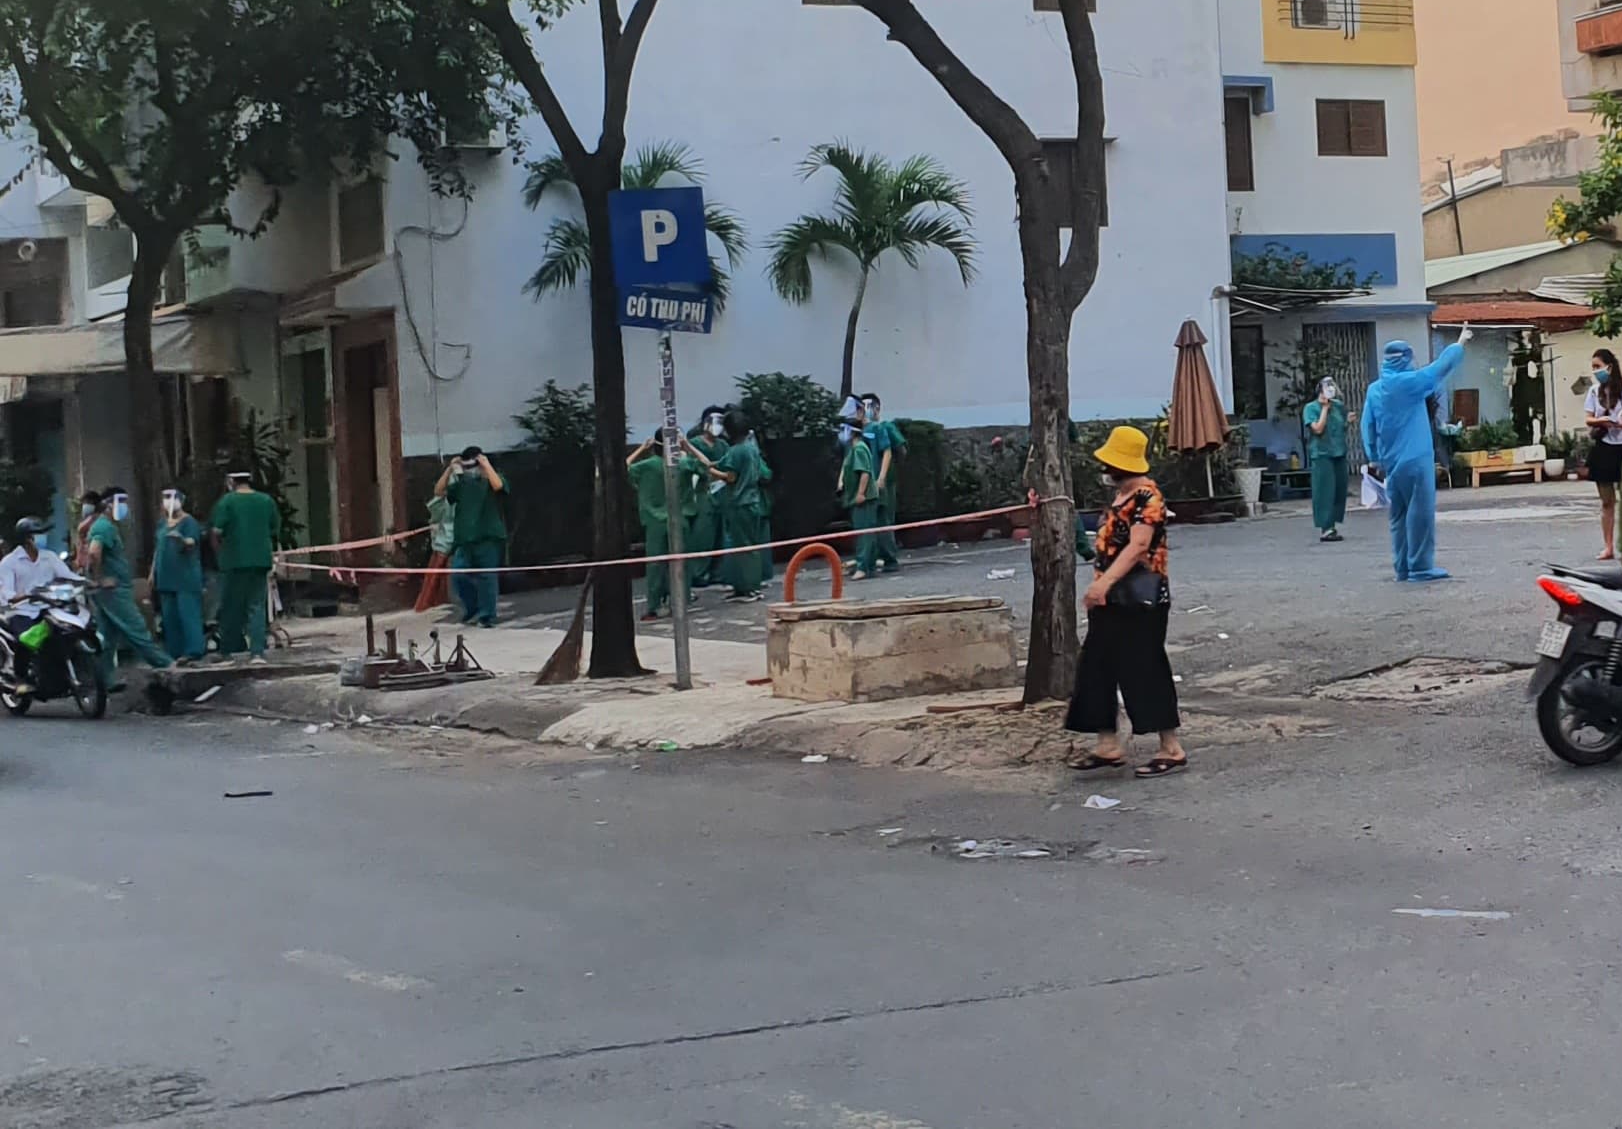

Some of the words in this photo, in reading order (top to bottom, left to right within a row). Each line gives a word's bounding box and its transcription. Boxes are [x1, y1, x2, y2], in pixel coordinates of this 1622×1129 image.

[640, 209, 678, 262] P
[625, 292, 648, 317] CÓ
[650, 298, 679, 321] THU
[681, 297, 708, 324] PHÍ
